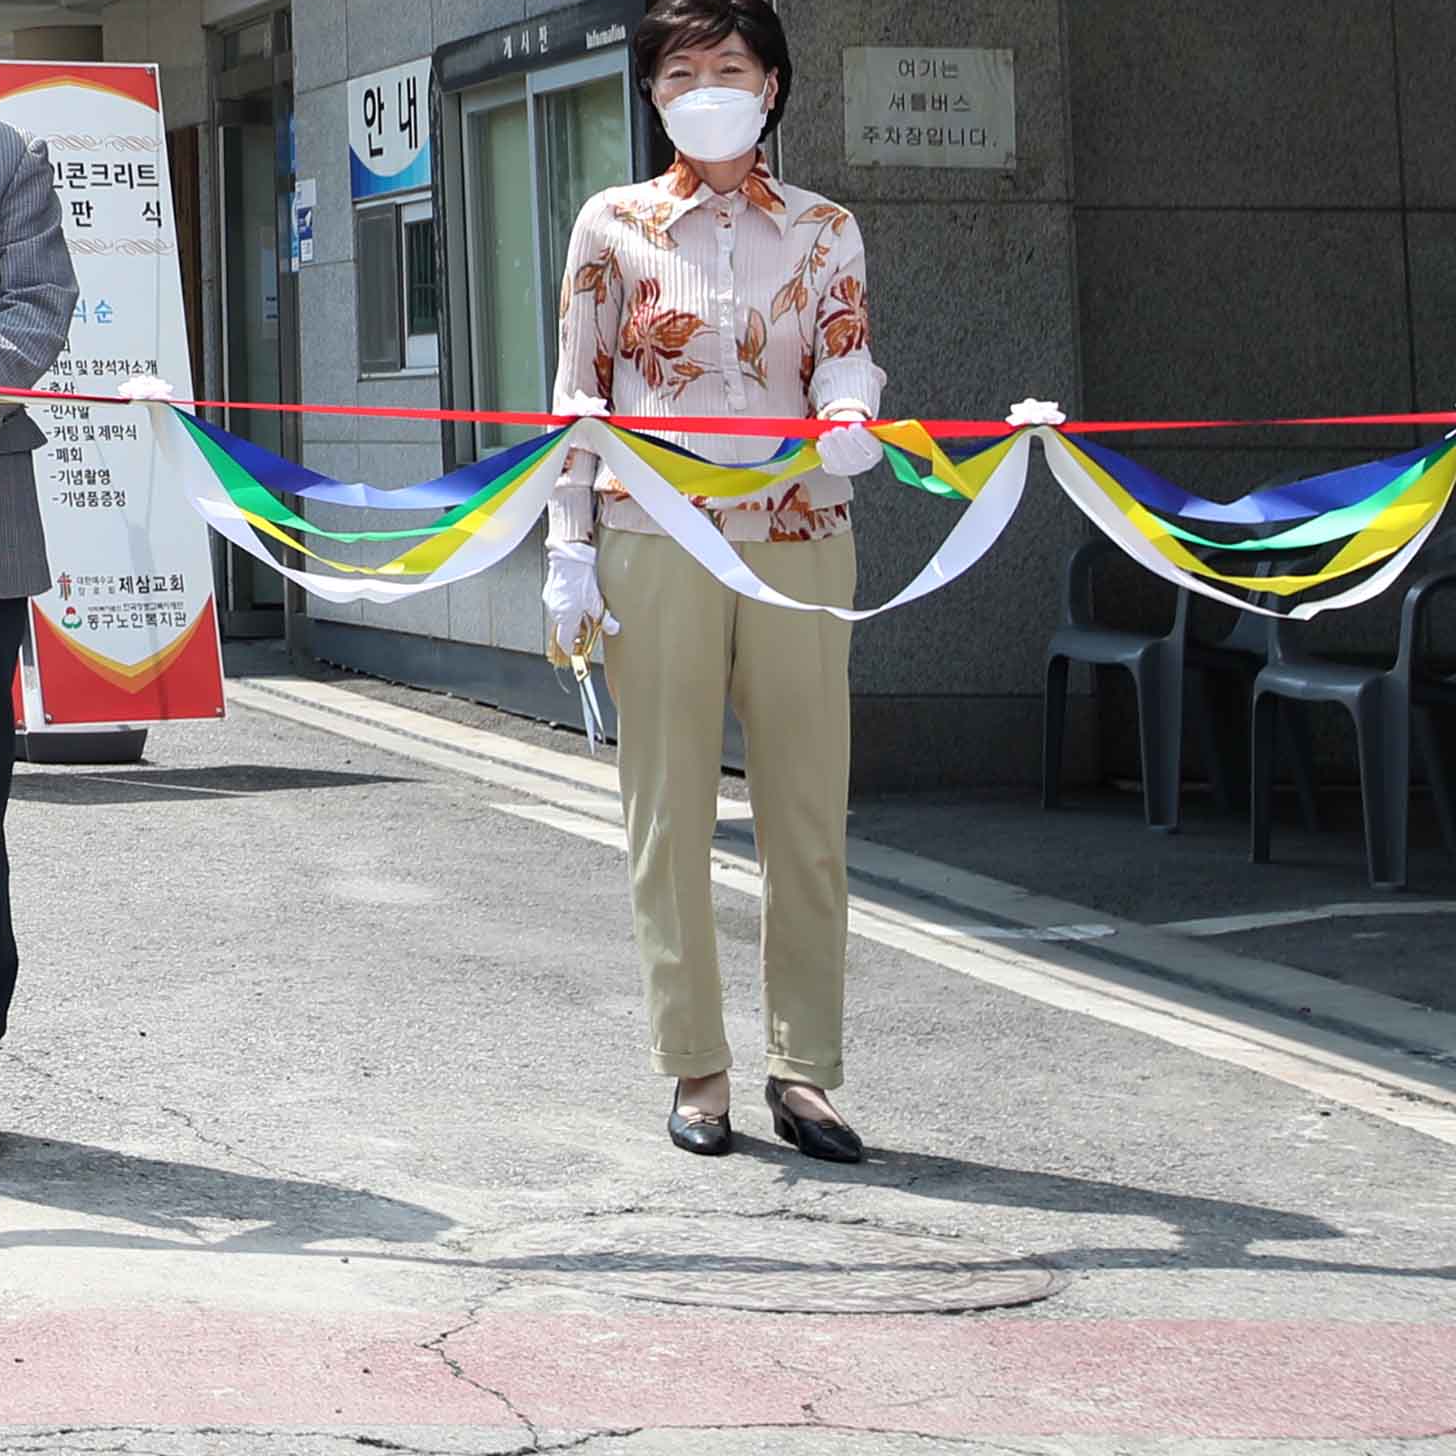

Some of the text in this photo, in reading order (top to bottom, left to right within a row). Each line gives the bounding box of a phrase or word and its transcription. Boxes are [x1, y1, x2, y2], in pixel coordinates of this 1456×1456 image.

[898, 58, 959, 79] 여기는
[888, 93, 971, 112] 셔틀버스
[363, 76, 419, 158] 안내
[862, 125, 998, 147] 주차장입니다.
[70, 200, 163, 229] 판 식
[75, 360, 89, 376] 및
[91, 359, 159, 376] 참석자소개
[82, 425, 96, 441] 및
[98, 424, 138, 441] 제막식
[119, 573, 185, 595] 제삼교회
[88, 611, 187, 631] 동구노인복지관
